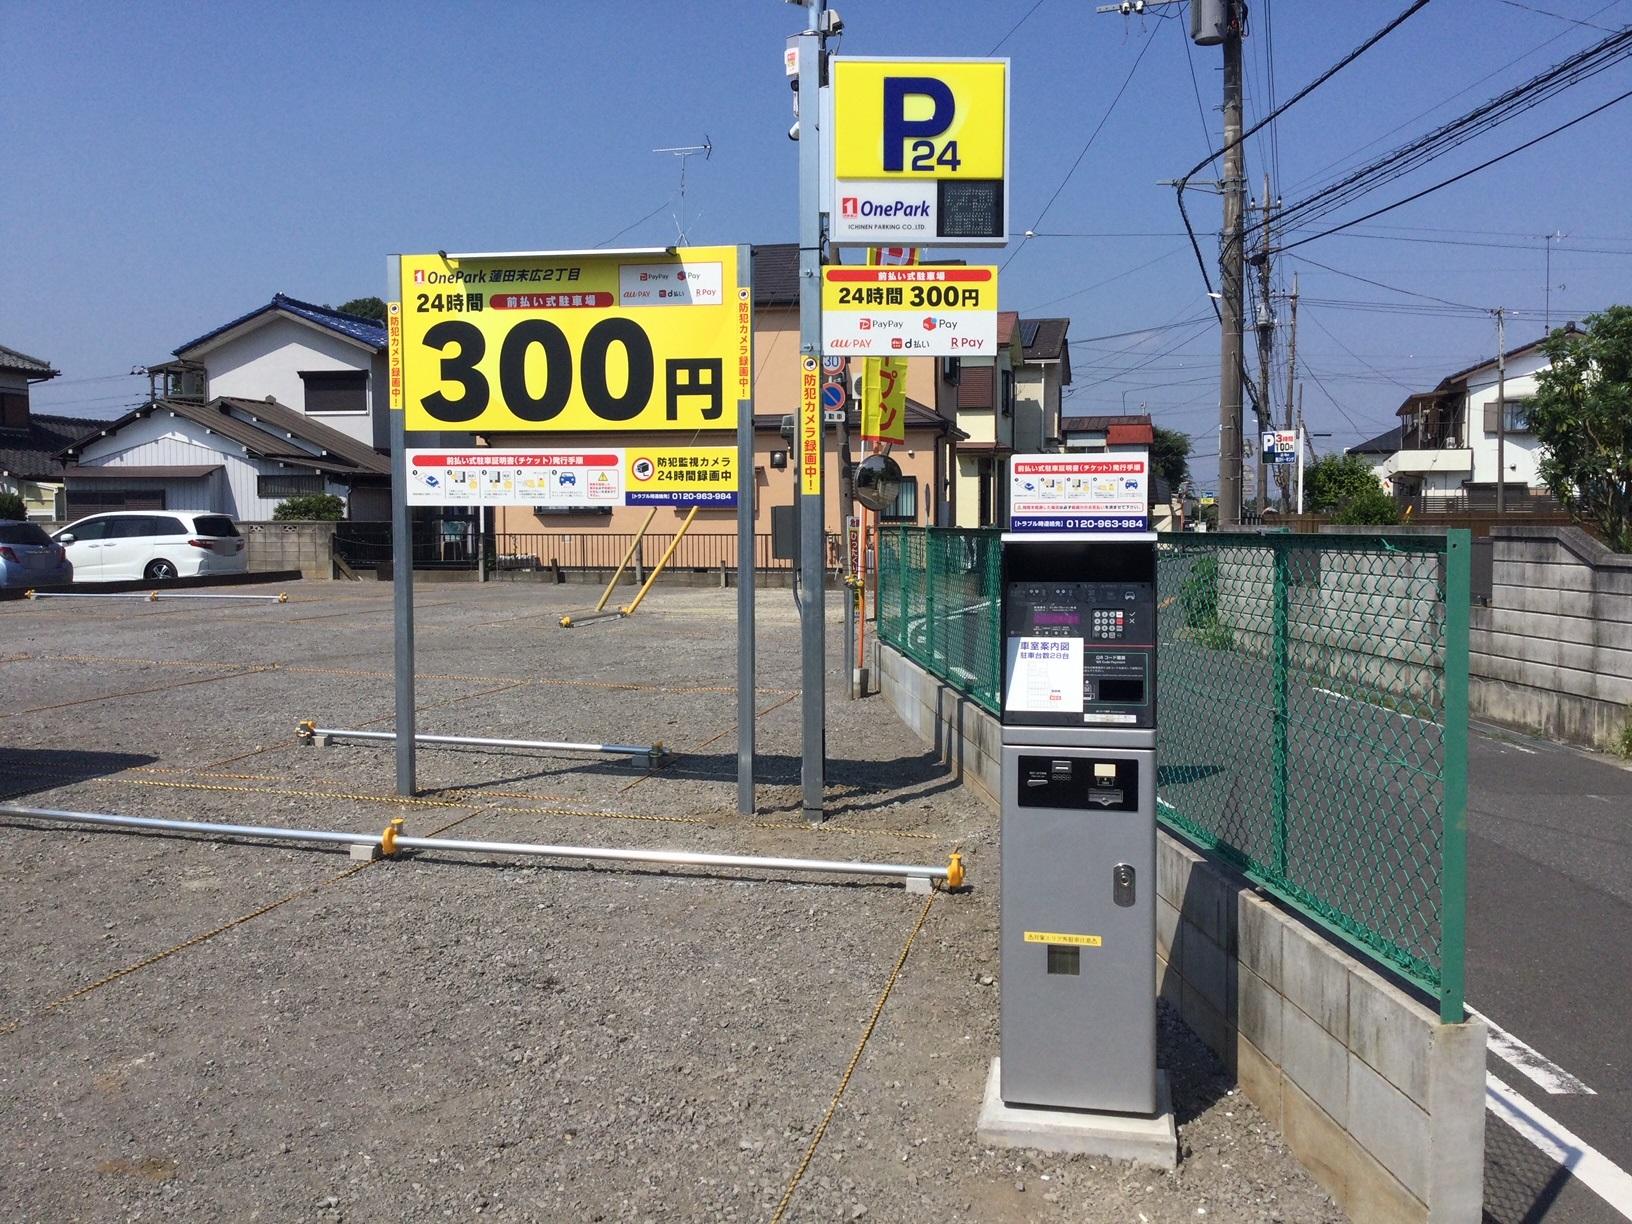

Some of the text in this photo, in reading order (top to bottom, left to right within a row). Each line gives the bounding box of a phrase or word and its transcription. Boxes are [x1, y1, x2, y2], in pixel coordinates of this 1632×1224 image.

[882, 76, 962, 172] P 24
[860, 200, 931, 217] OnePark
[427, 270, 487, 285] OnePark
[488, 268, 582, 283] 蓮田末広2丁目
[648, 272, 701, 281] PayPay Pay
[877, 271, 946, 281] 前払い式駐車場
[702, 289, 717, 297] Pay
[838, 286, 980, 308] 24時間 300円
[416, 293, 484, 313] 24時間
[506, 295, 597, 308] 前払い式駐車場
[872, 319, 958, 330] PayPay Pay
[830, 337, 984, 349] au PAY d払い R Pay
[419, 316, 724, 423] 300円
[1263, 434, 1275, 452] P
[657, 456, 732, 468] 防犯監視カメラ
[657, 470, 733, 482] 24時間録画中
[1066, 519, 1144, 528] 0120-963-984
[1020, 641, 1070, 651] 車室案内図
[1020, 652, 1070, 660] 駐車台数28台
